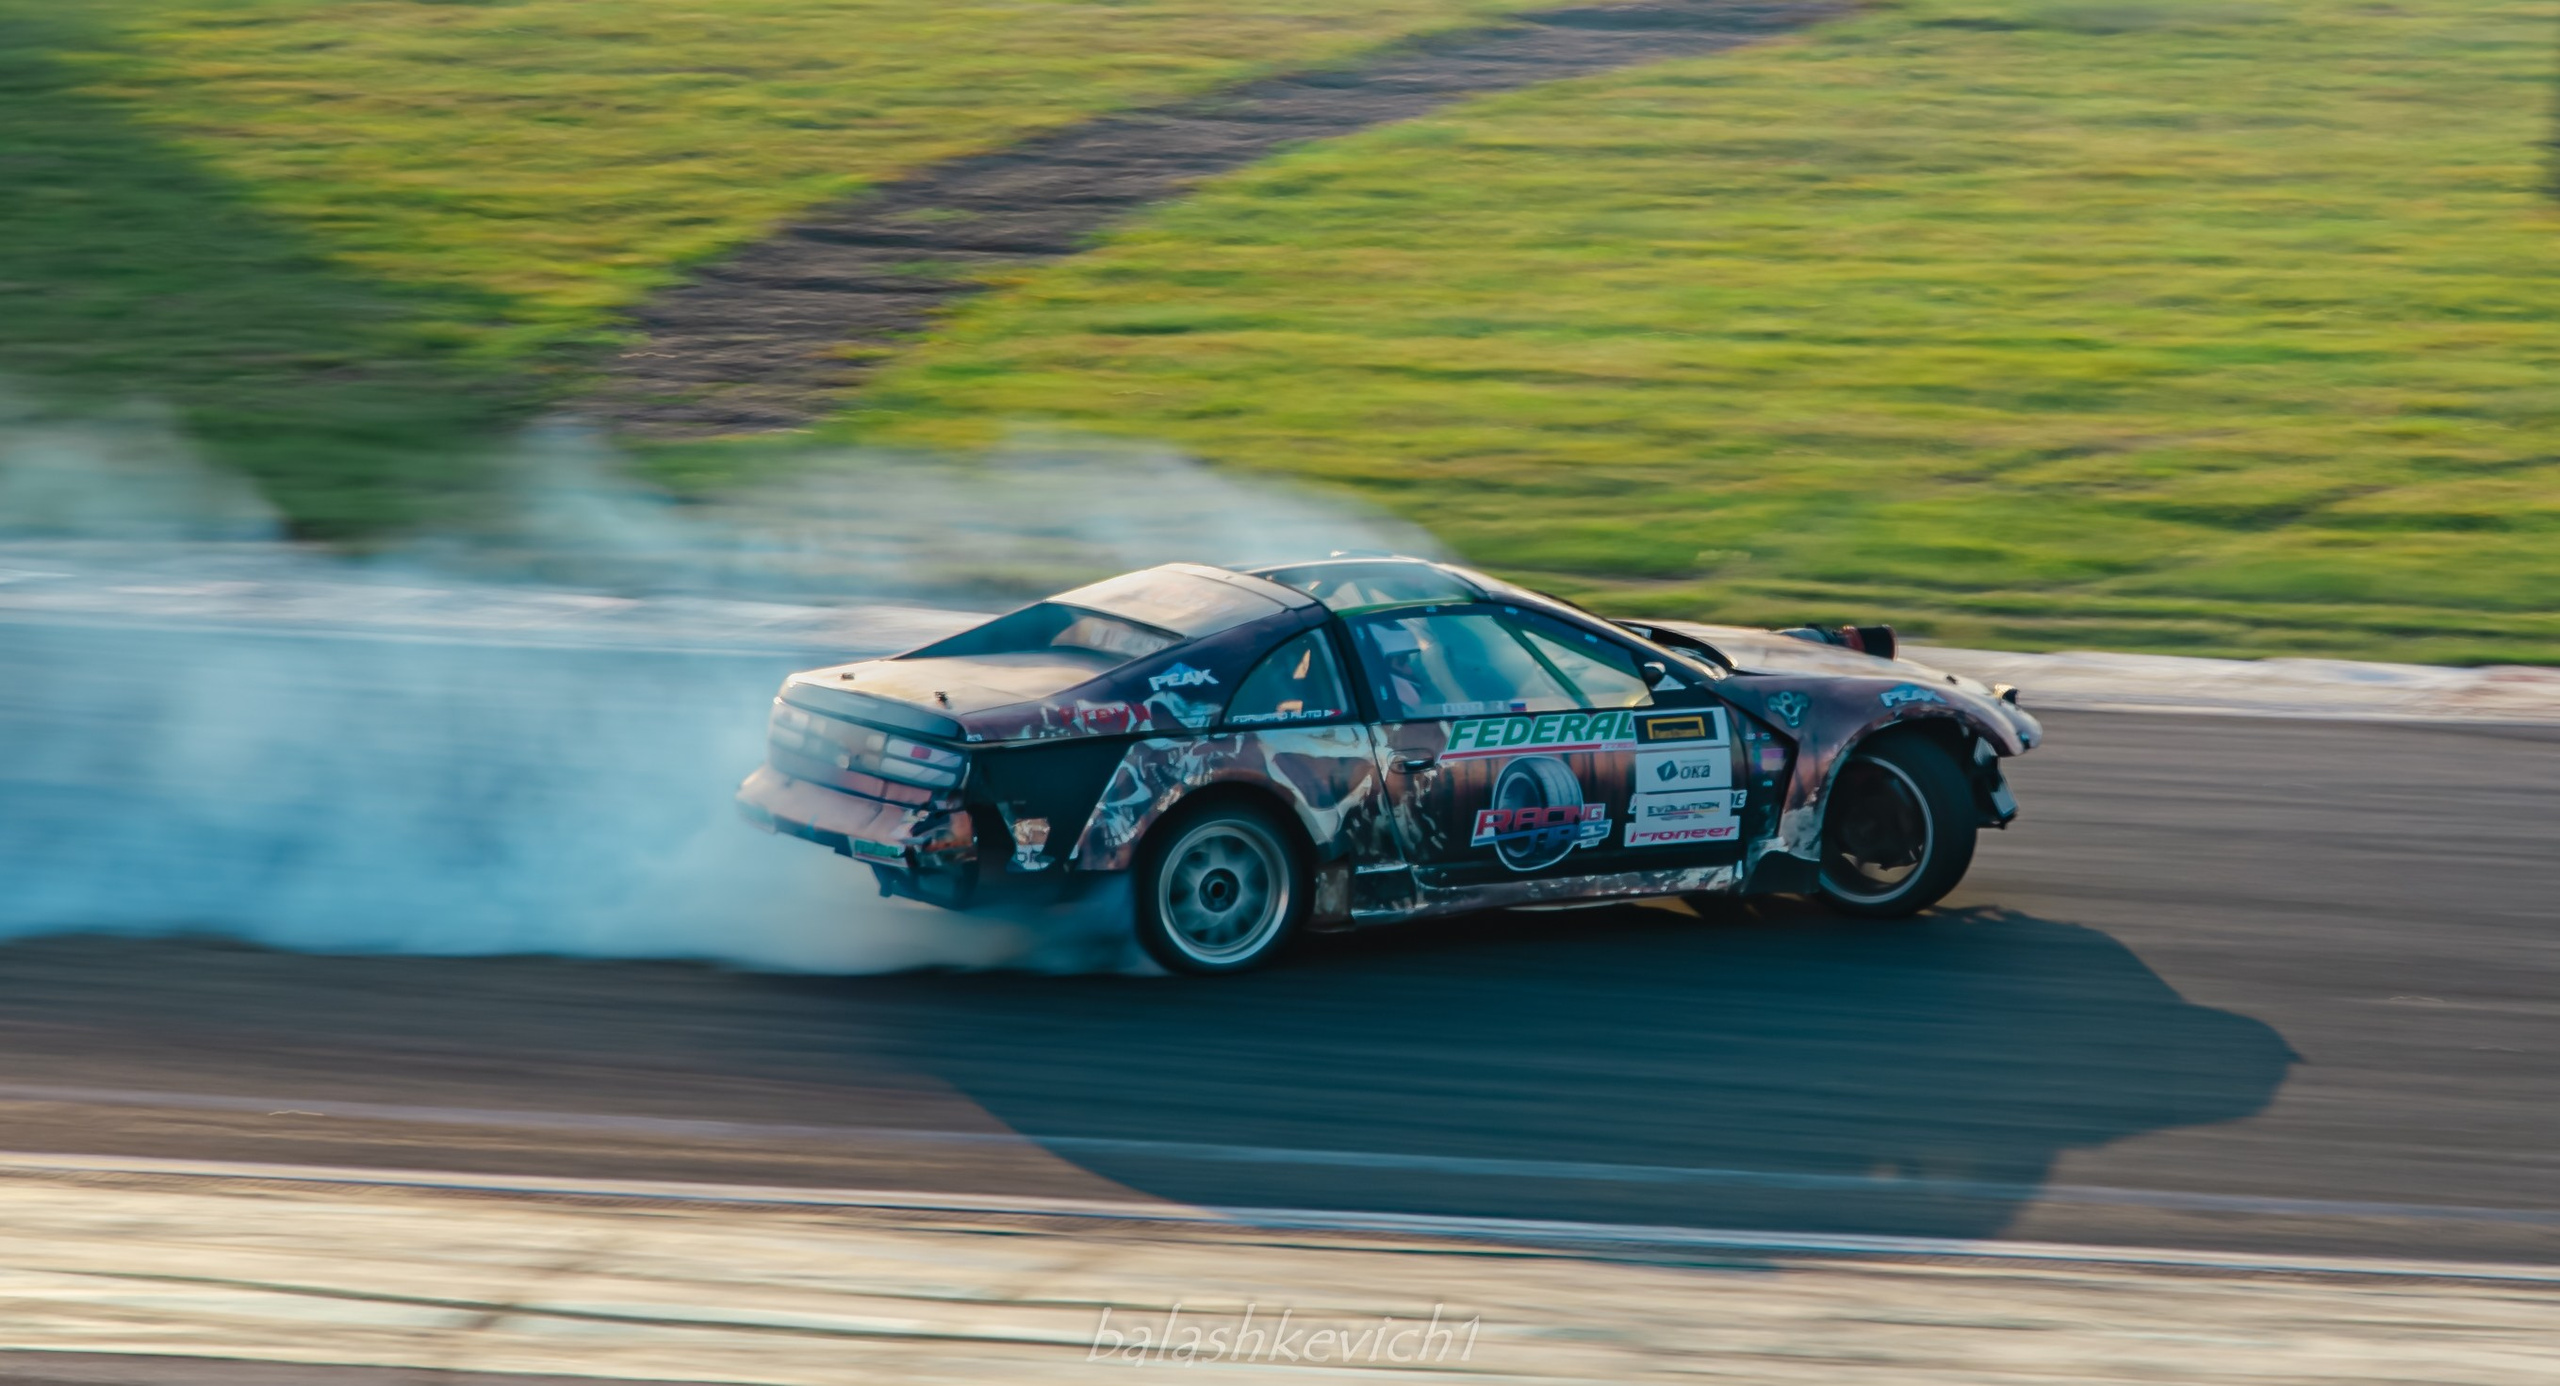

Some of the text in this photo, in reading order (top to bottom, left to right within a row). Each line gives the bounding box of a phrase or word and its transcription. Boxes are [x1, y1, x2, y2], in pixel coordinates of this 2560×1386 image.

[1149, 669, 1219, 691] PEAK
[1880, 688, 1947, 707] PEAK
[1448, 712, 1634, 750] FEDERAL
